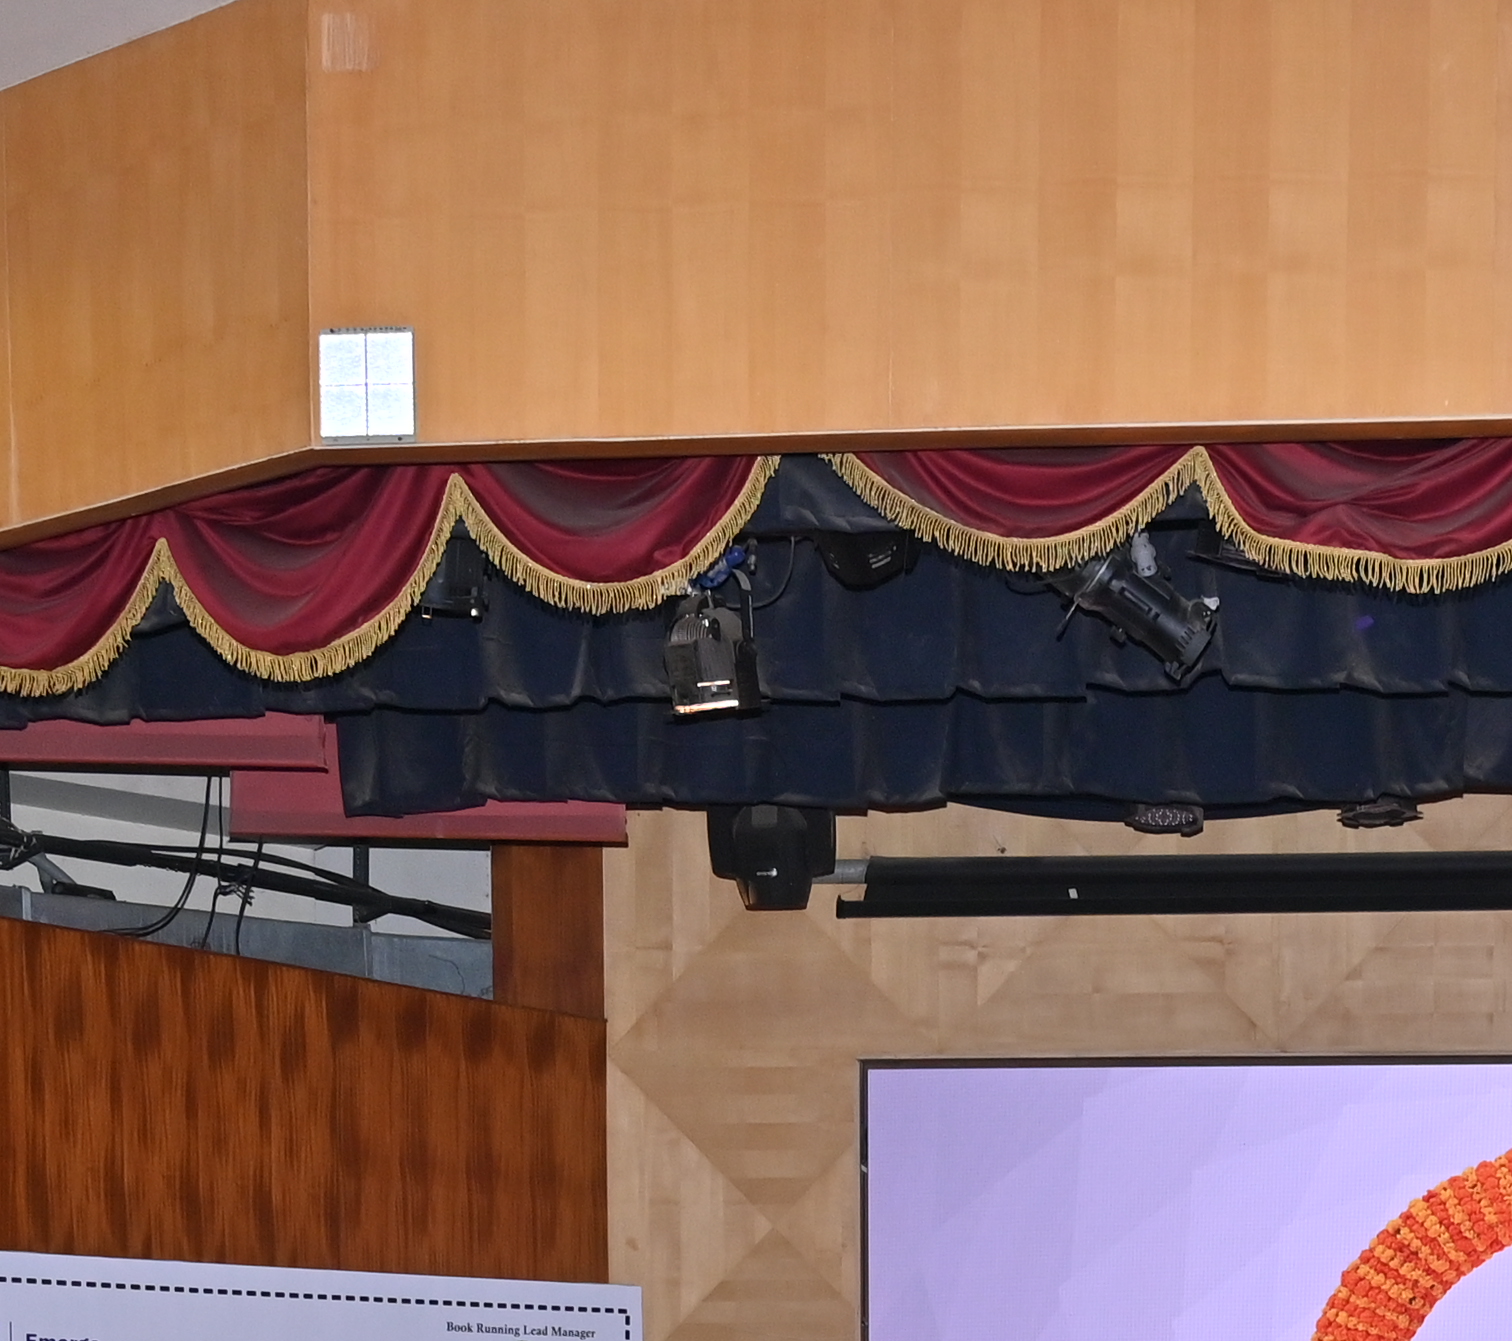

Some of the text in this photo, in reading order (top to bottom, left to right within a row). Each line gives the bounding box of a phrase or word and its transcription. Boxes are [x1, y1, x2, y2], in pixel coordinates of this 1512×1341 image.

[447, 1322, 595, 1340] Book Running Lead Manager
